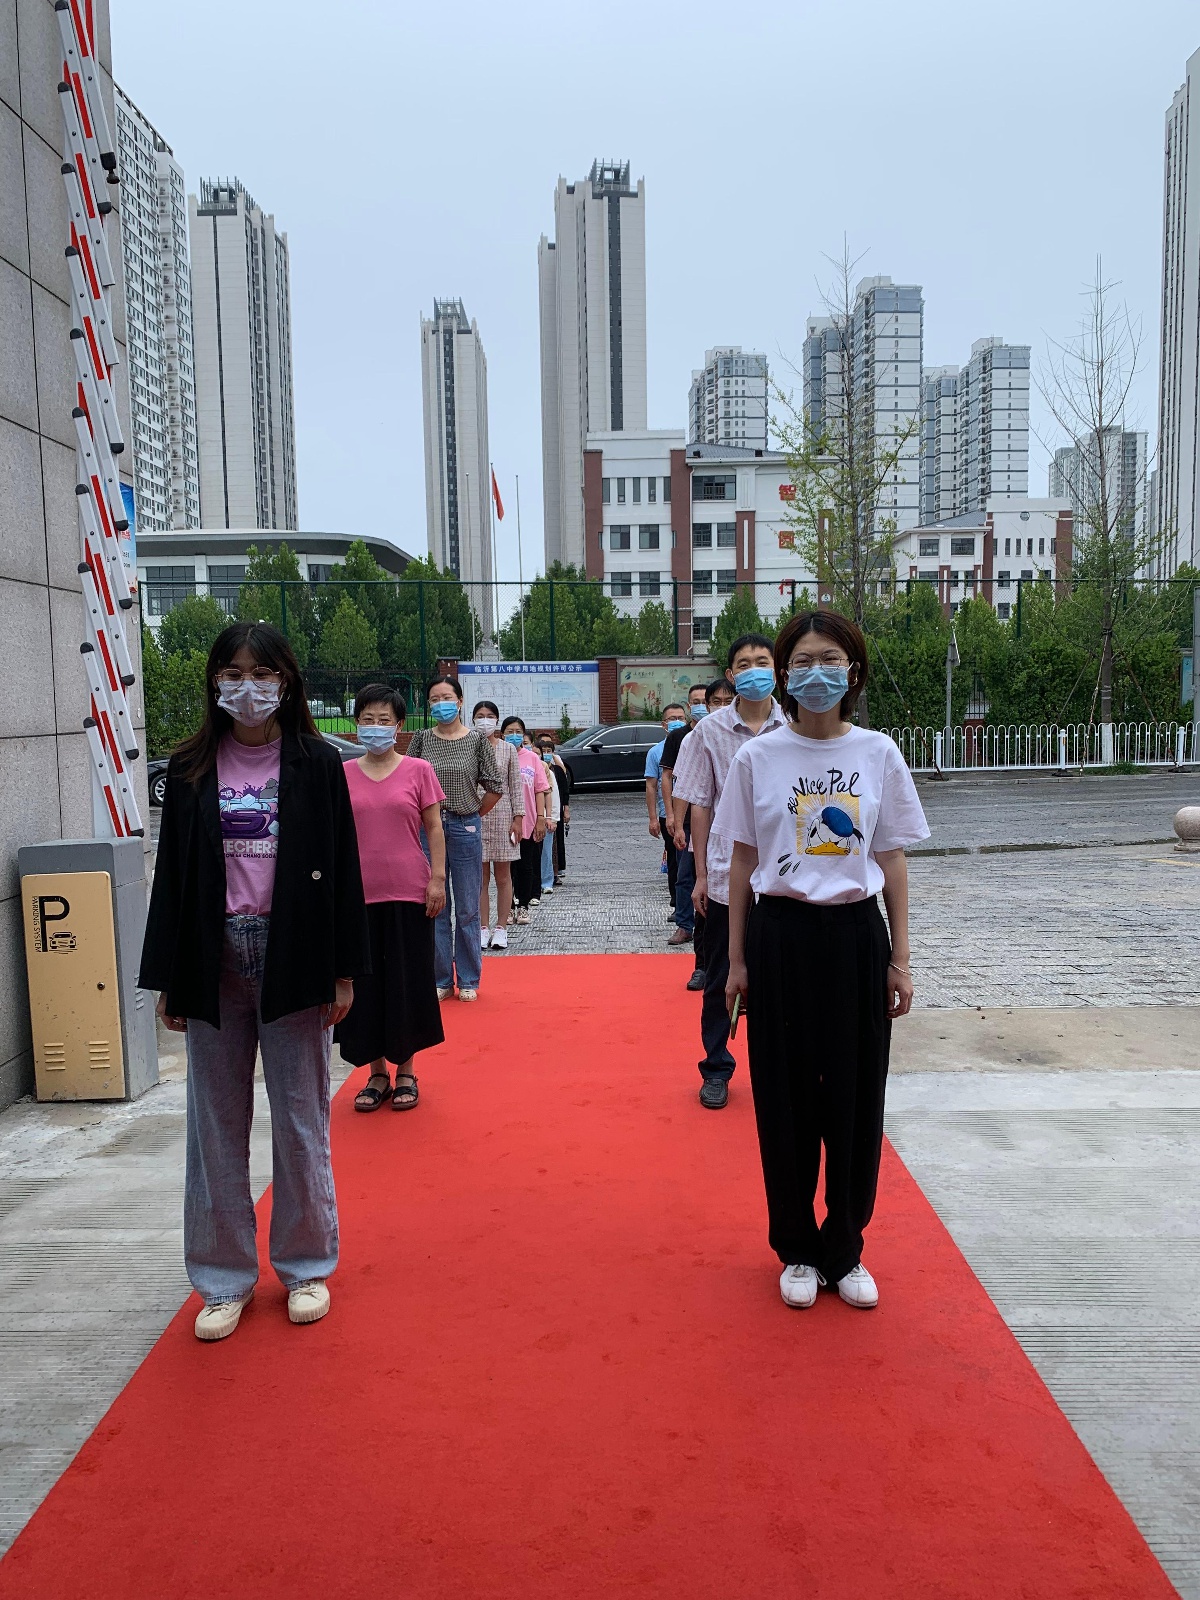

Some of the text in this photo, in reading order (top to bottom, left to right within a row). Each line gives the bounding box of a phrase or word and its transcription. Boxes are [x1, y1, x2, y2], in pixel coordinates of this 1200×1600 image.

[474, 665, 583, 673] 临沂第八中学用地规划许可公示
[827, 767, 862, 797] Pal
[32, 896, 42, 953] PARKING SYSTEM
[39, 896, 70, 952] P
